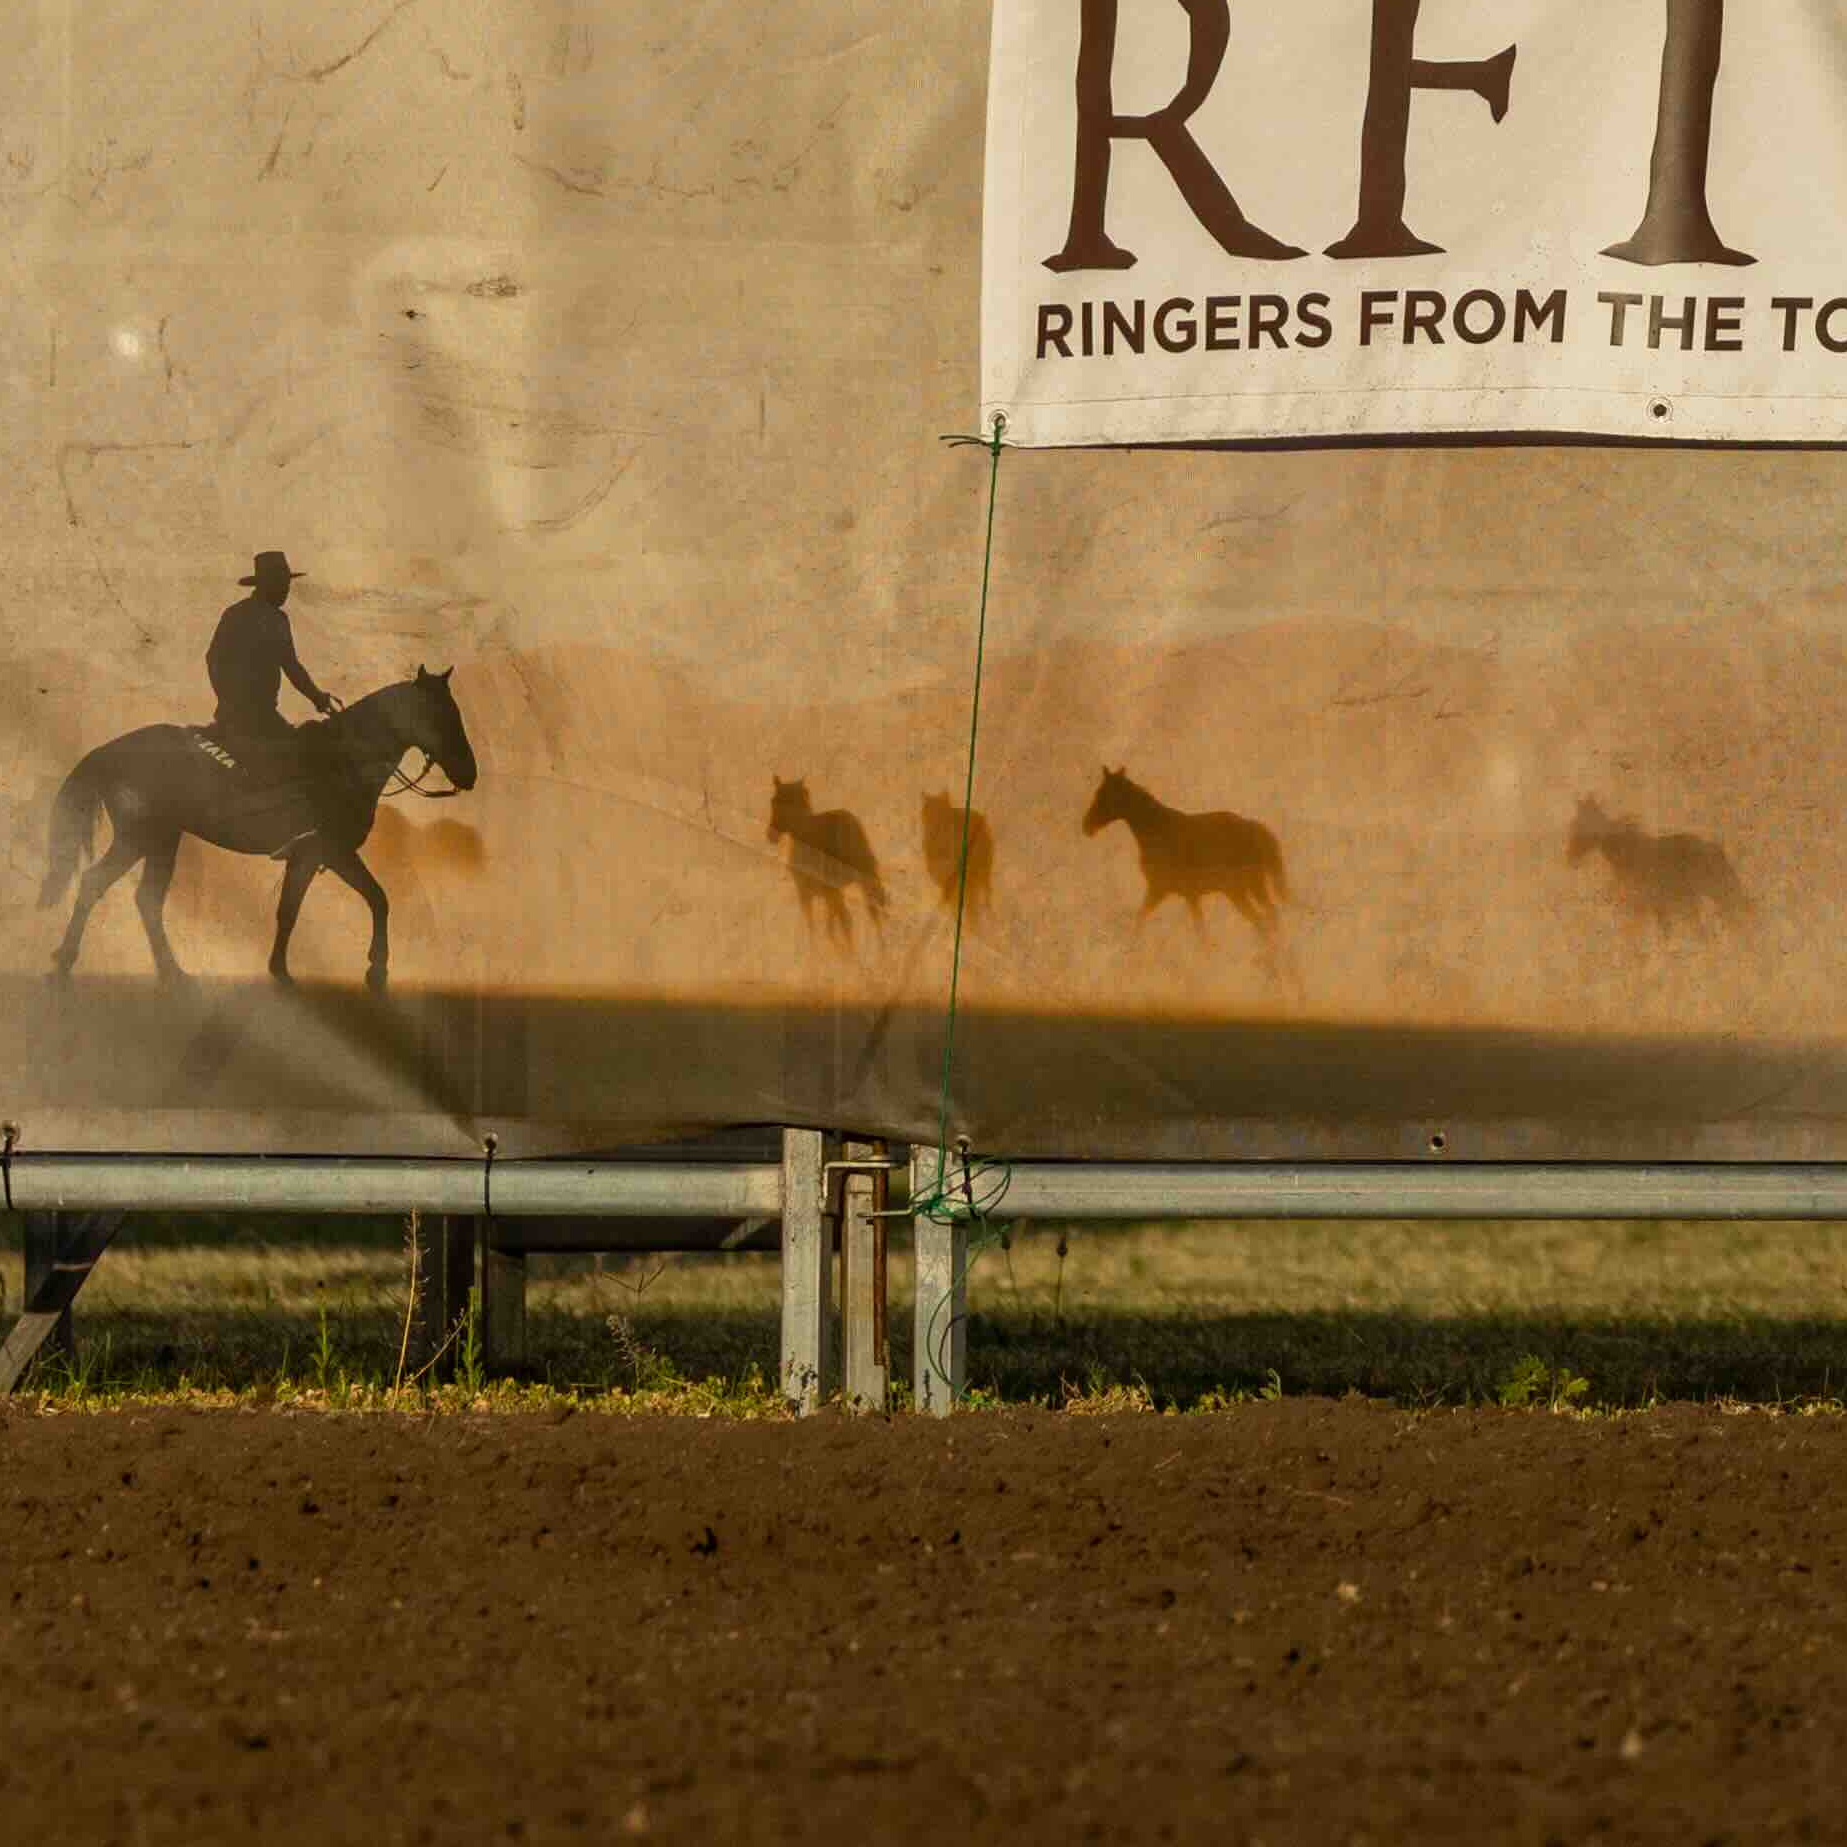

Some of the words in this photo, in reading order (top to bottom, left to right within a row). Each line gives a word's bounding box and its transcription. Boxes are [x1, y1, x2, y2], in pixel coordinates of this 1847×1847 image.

[1034, 293, 1333, 357] RINGERS
[1357, 288, 1567, 346] FROM
[1600, 292, 1743, 353] THE
